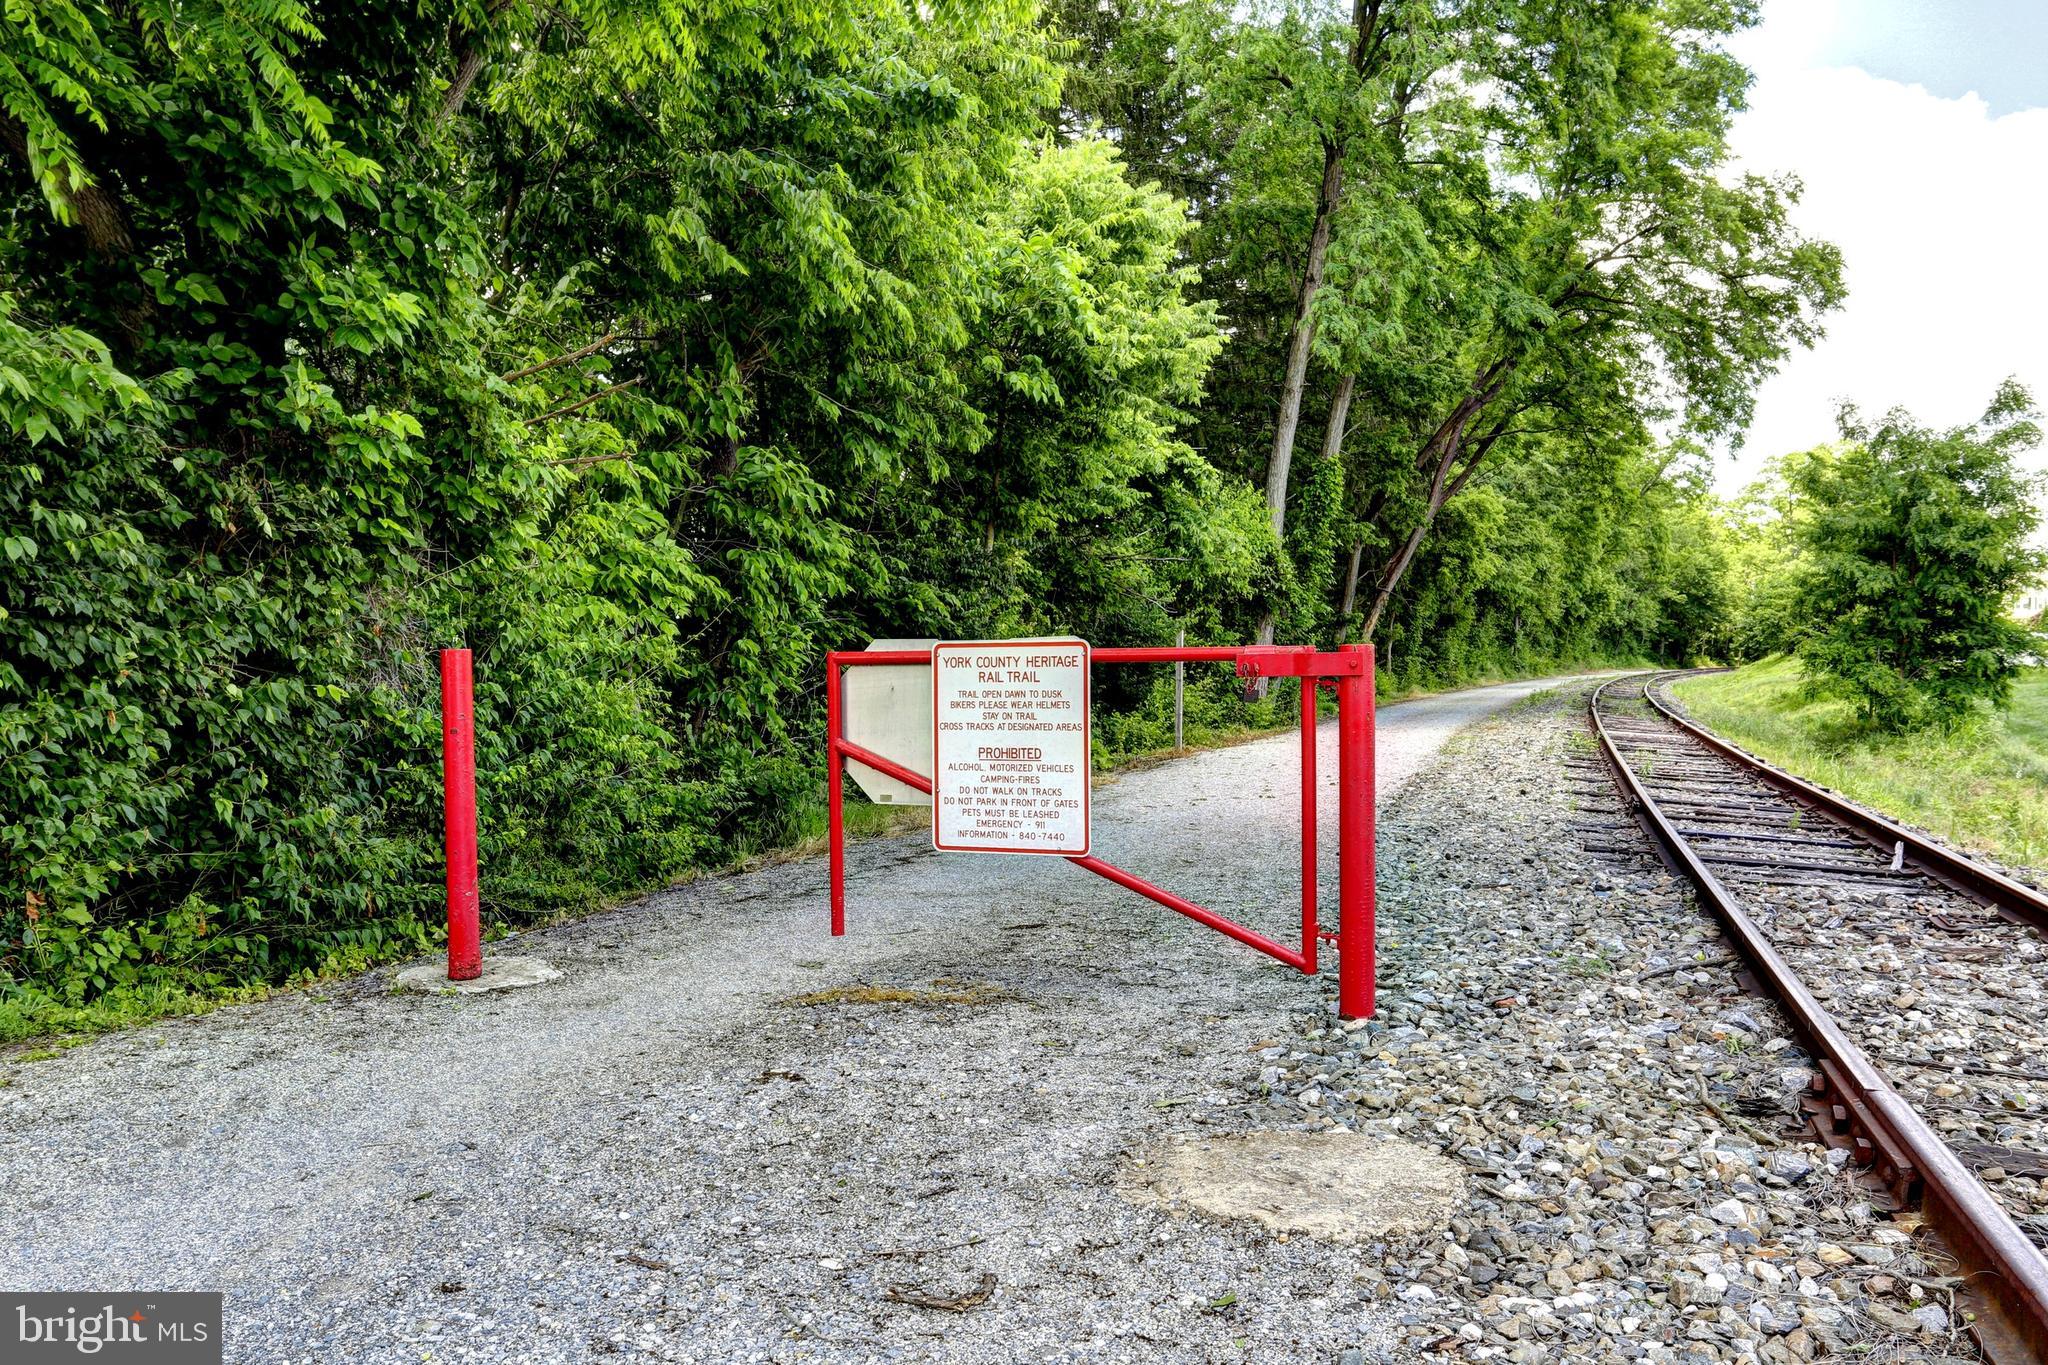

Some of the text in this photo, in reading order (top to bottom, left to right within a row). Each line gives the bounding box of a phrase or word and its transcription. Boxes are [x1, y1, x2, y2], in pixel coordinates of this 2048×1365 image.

[943, 656, 1078, 668] YORK COUNTY HERITAGE
[979, 671, 1040, 682] RAIL TRAIL
[982, 690, 1001, 698] OPEN
[1005, 690, 1026, 698] DAWN
[1030, 690, 1038, 698] TO
[1042, 690, 1062, 698] DUSK
[983, 712, 1037, 720] STAY ON TRAIL
[1008, 723, 1053, 731] DESIGNATED
[1056, 723, 1082, 731] AREAS
[979, 748, 1041, 759] PROHIBITED
[990, 764, 1033, 772] MOTORIZED
[1037, 764, 1074, 772] VEHICLES
[981, 775, 1040, 783] CAMPING-FIRES
[992, 787, 1013, 795] WALK
[1032, 788, 1062, 796] TRACKS
[944, 797, 1078, 808] DO NOT PARK IN FRONT OF GATES
[962, 809, 981, 817] PETS
[985, 809, 1005, 817] MUST
[1023, 810, 1059, 818] LEASHED
[976, 820, 1022, 828] EMERGENCY
[958, 830, 1008, 839] INFORMATION
